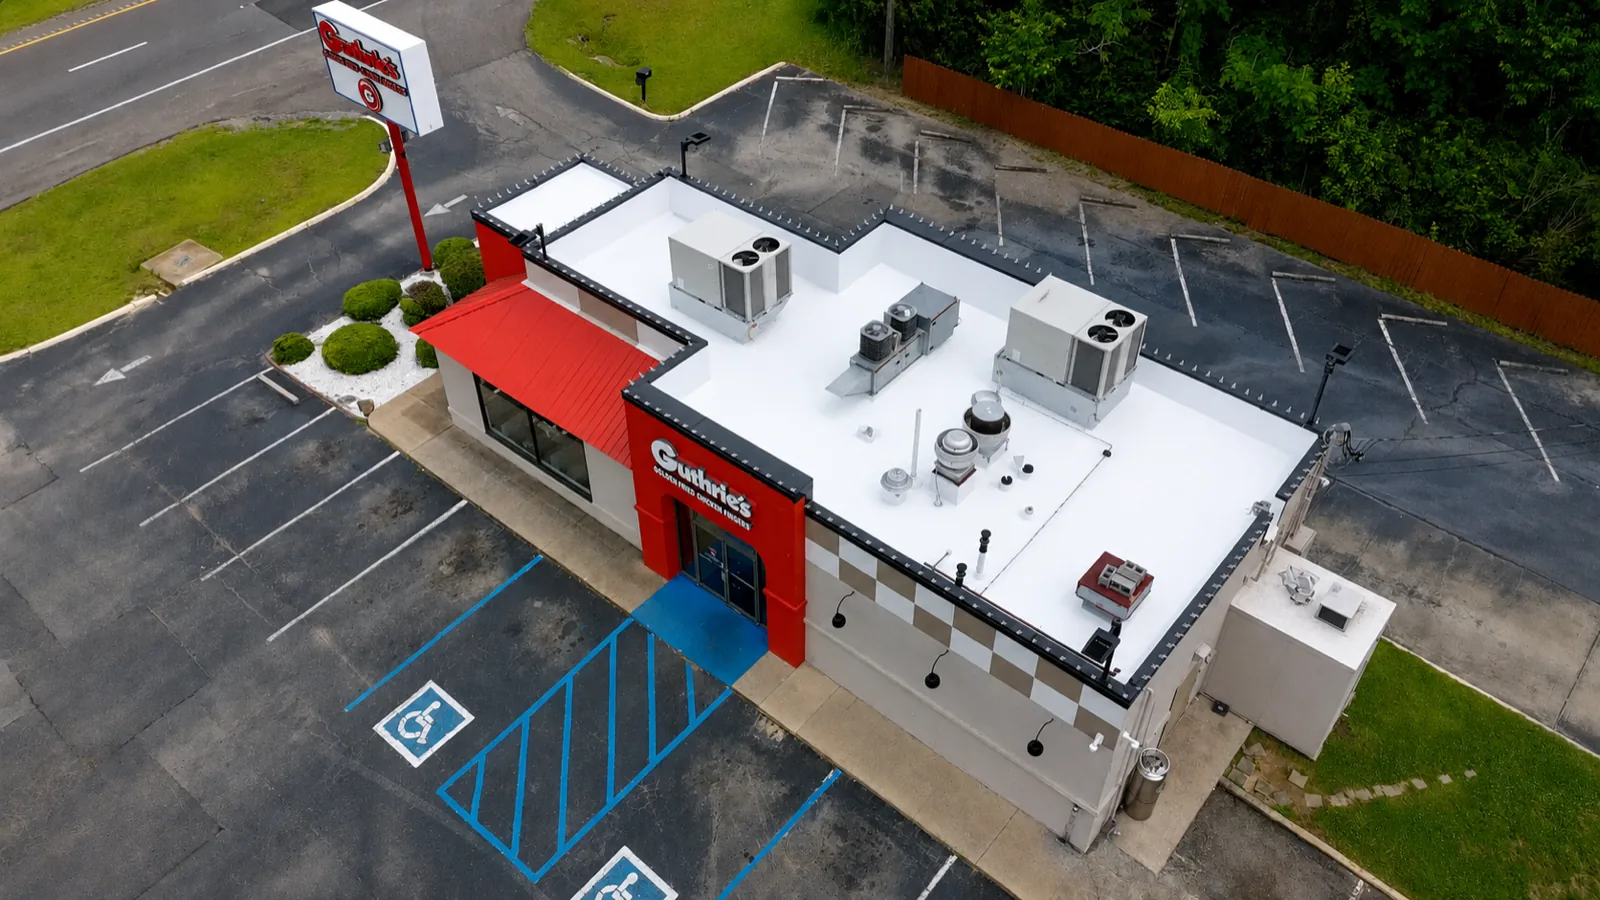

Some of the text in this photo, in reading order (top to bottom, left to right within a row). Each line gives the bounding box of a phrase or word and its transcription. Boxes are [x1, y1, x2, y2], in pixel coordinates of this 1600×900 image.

[651, 439, 752, 519] Guthrie's
[696, 492, 723, 514] CHICKEN
[723, 508, 751, 531] FINGERS
